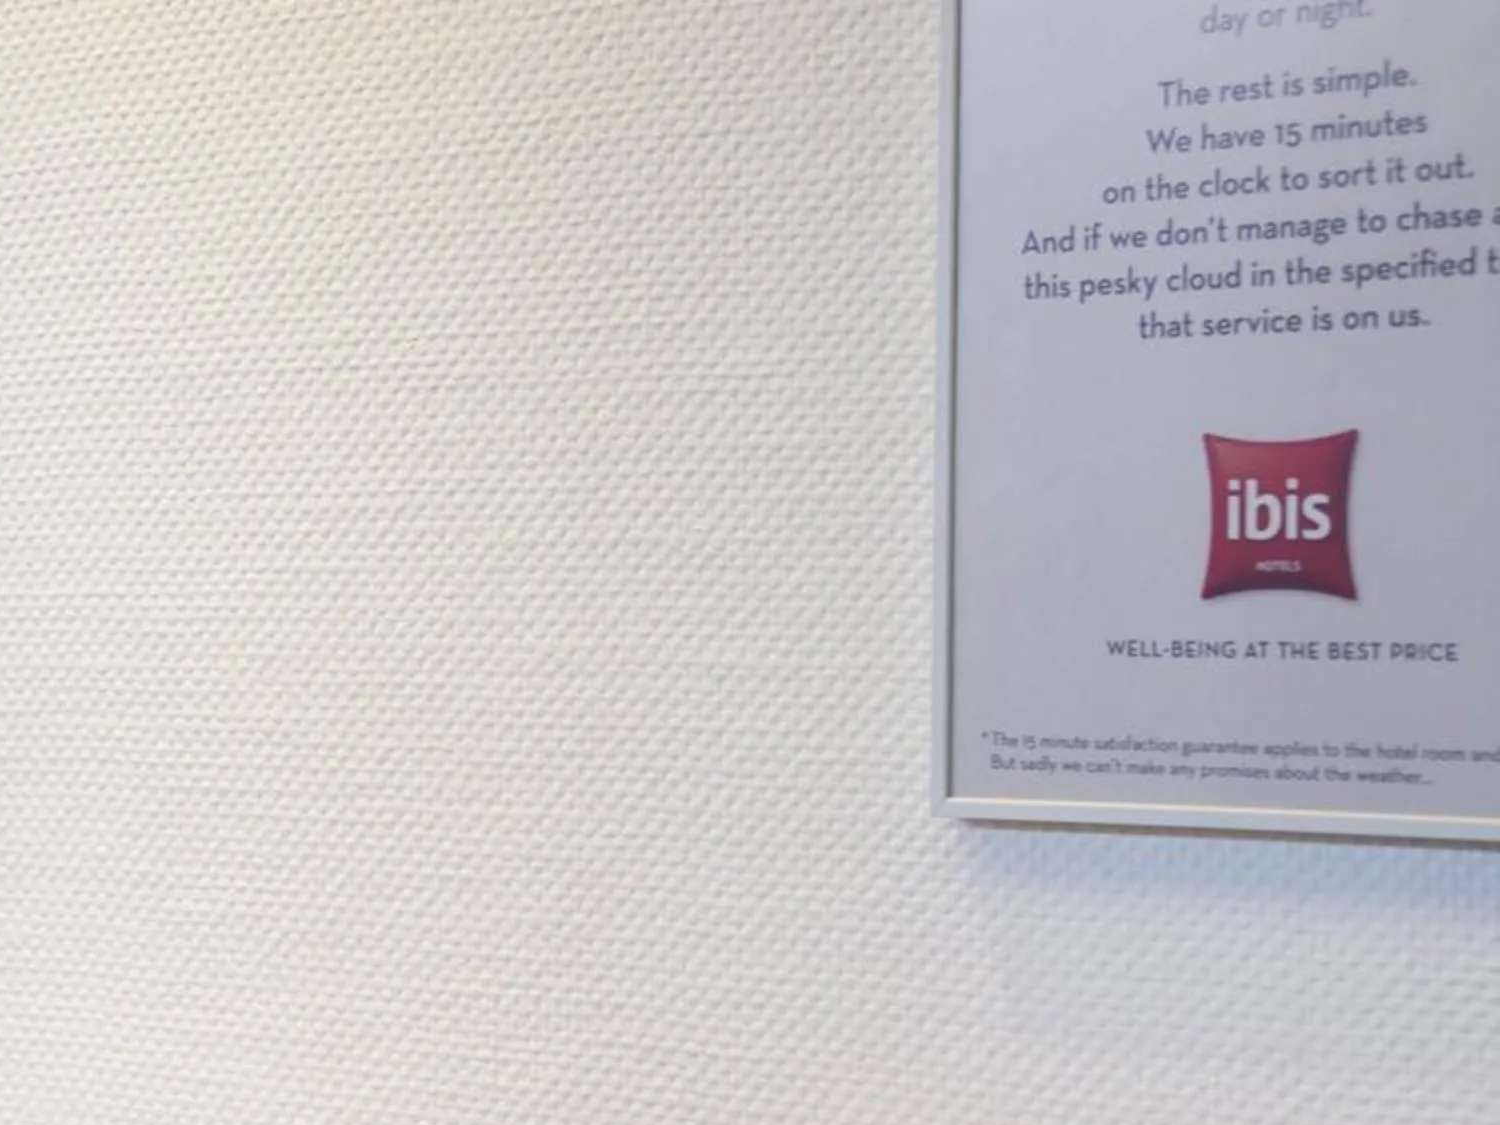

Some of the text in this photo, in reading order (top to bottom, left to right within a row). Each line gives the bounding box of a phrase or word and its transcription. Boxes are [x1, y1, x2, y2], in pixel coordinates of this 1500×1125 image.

[1200, 0, 1373, 38] day or night.
[1158, 58, 1419, 108] The rest is simple.
[1146, 110, 1429, 153] We have 15 minutes
[1102, 152, 1475, 204] on the clock to sort it out.
[1021, 224, 1076, 254] And
[1083, 222, 1104, 251] if
[1109, 229, 1148, 248] we
[1156, 216, 1229, 247] don't
[1237, 216, 1347, 245] manage
[1357, 208, 1387, 234] to
[1396, 201, 1483, 231] chase
[1024, 271, 1071, 300] this
[1078, 265, 1158, 304] pesky
[1166, 259, 1242, 291] cloud
[1251, 262, 1275, 287] in
[1285, 256, 1332, 285] the
[1341, 246, 1478, 289] specified
[1139, 306, 1431, 340] that service is on us.
[1226, 477, 1332, 541] ibis
[1255, 560, 1302, 573] HOTELS
[1106, 640, 1460, 662] WELL-BEING AT THE BEST PRICE
[1040, 736, 1088, 750] minute
[990, 753, 1016, 770] But
[1020, 755, 1057, 774] sadly
[1275, 764, 1320, 781] about
